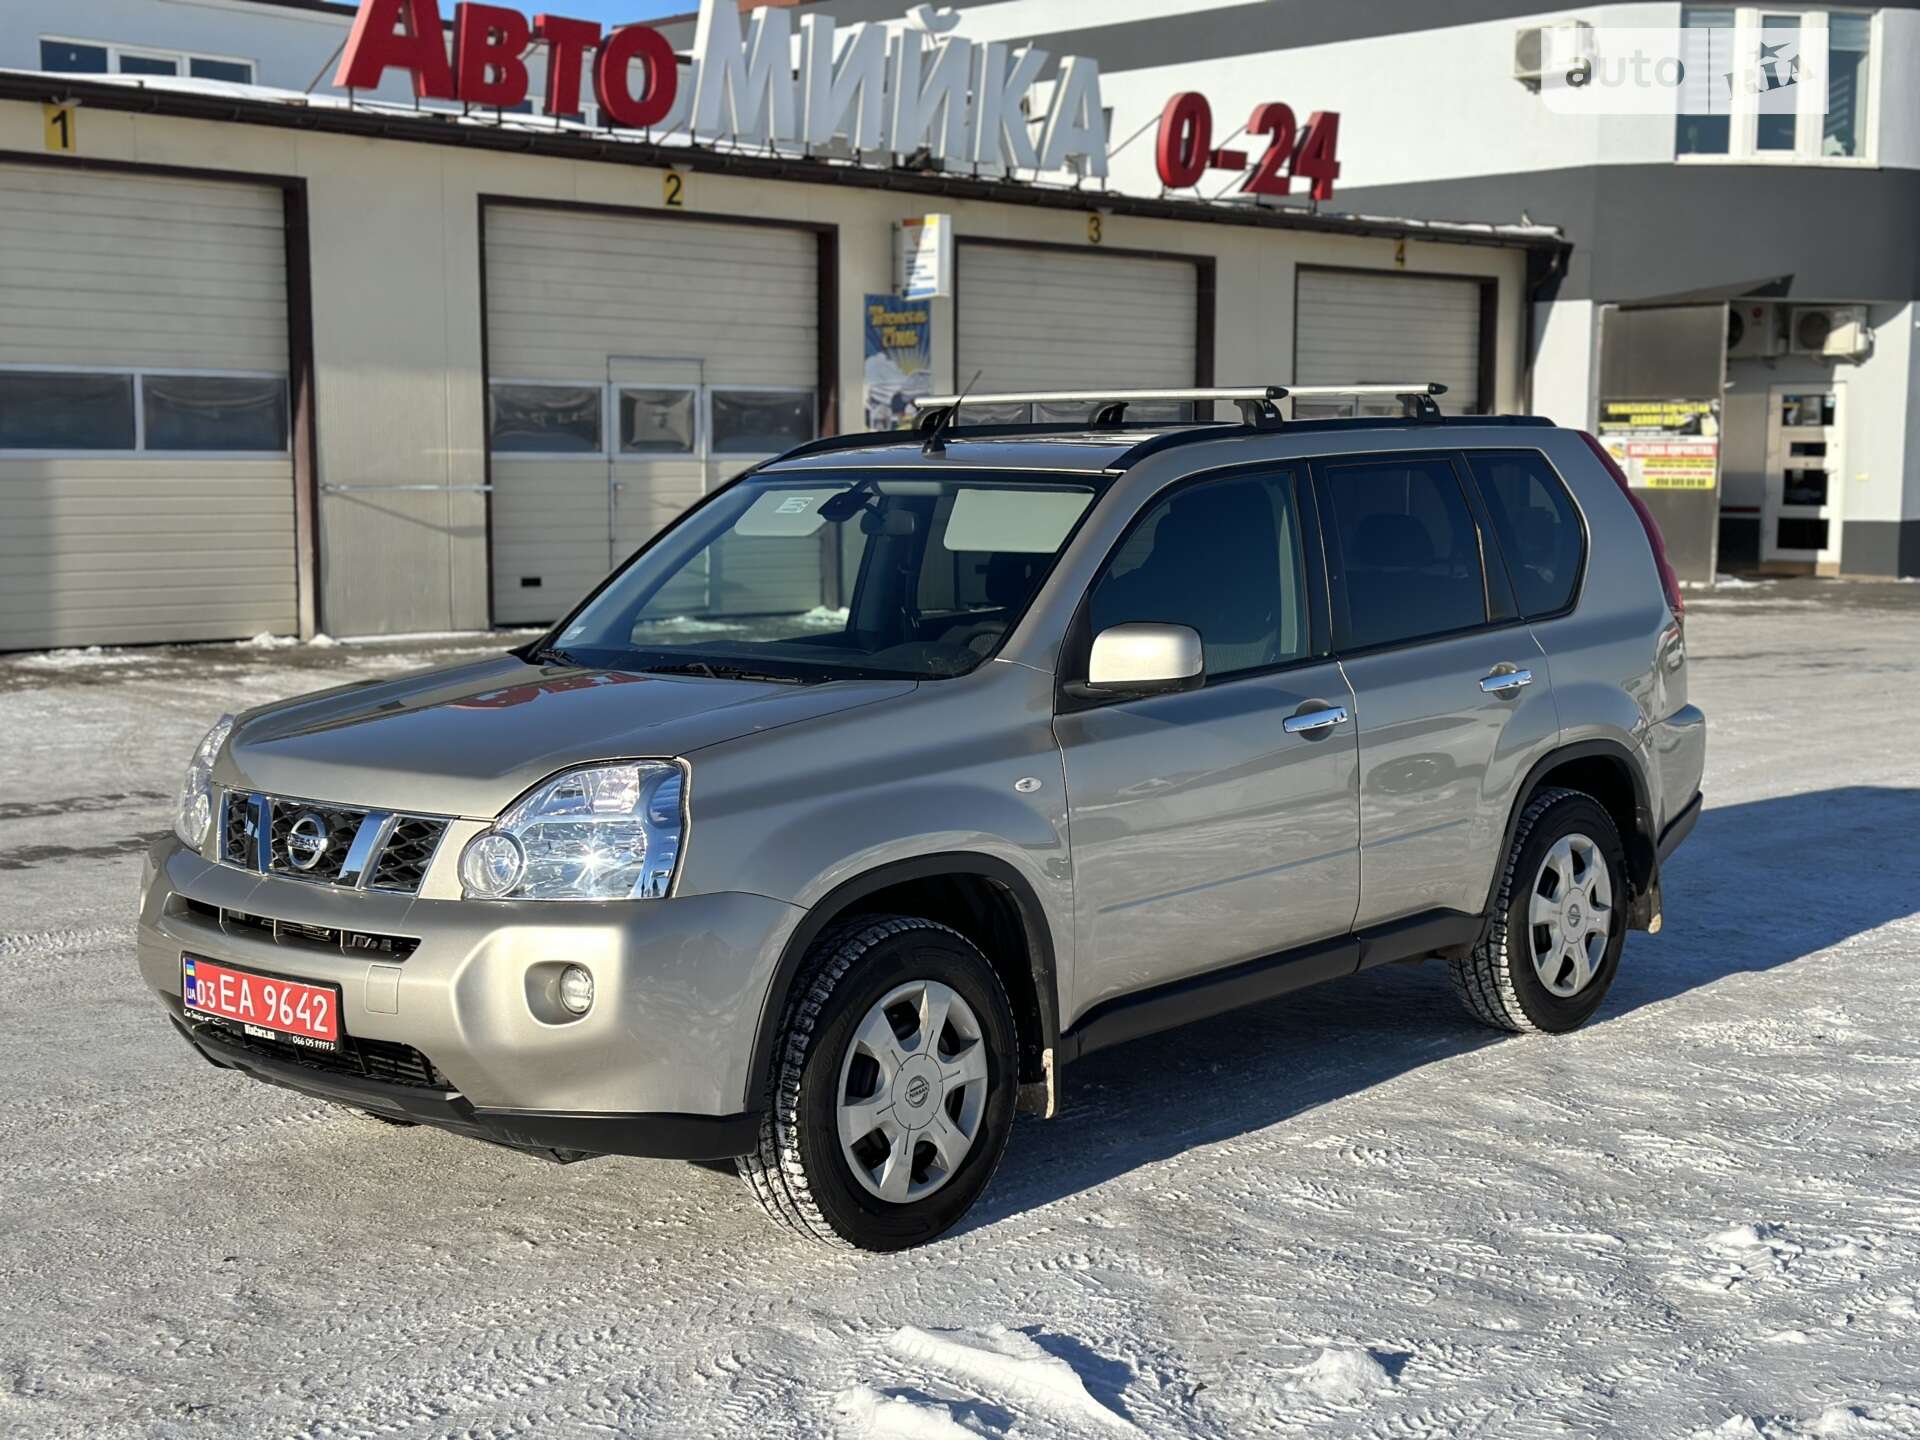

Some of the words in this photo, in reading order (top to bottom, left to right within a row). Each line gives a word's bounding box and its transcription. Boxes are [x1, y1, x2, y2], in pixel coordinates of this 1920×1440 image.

[52, 110, 69, 148] 1
[1156, 91, 1341, 200] 0-24
[666, 173, 682, 205] 2
[1089, 216, 1101, 243] 3
[1395, 243, 1405, 268] 4
[263, 985, 328, 1033] 9642
